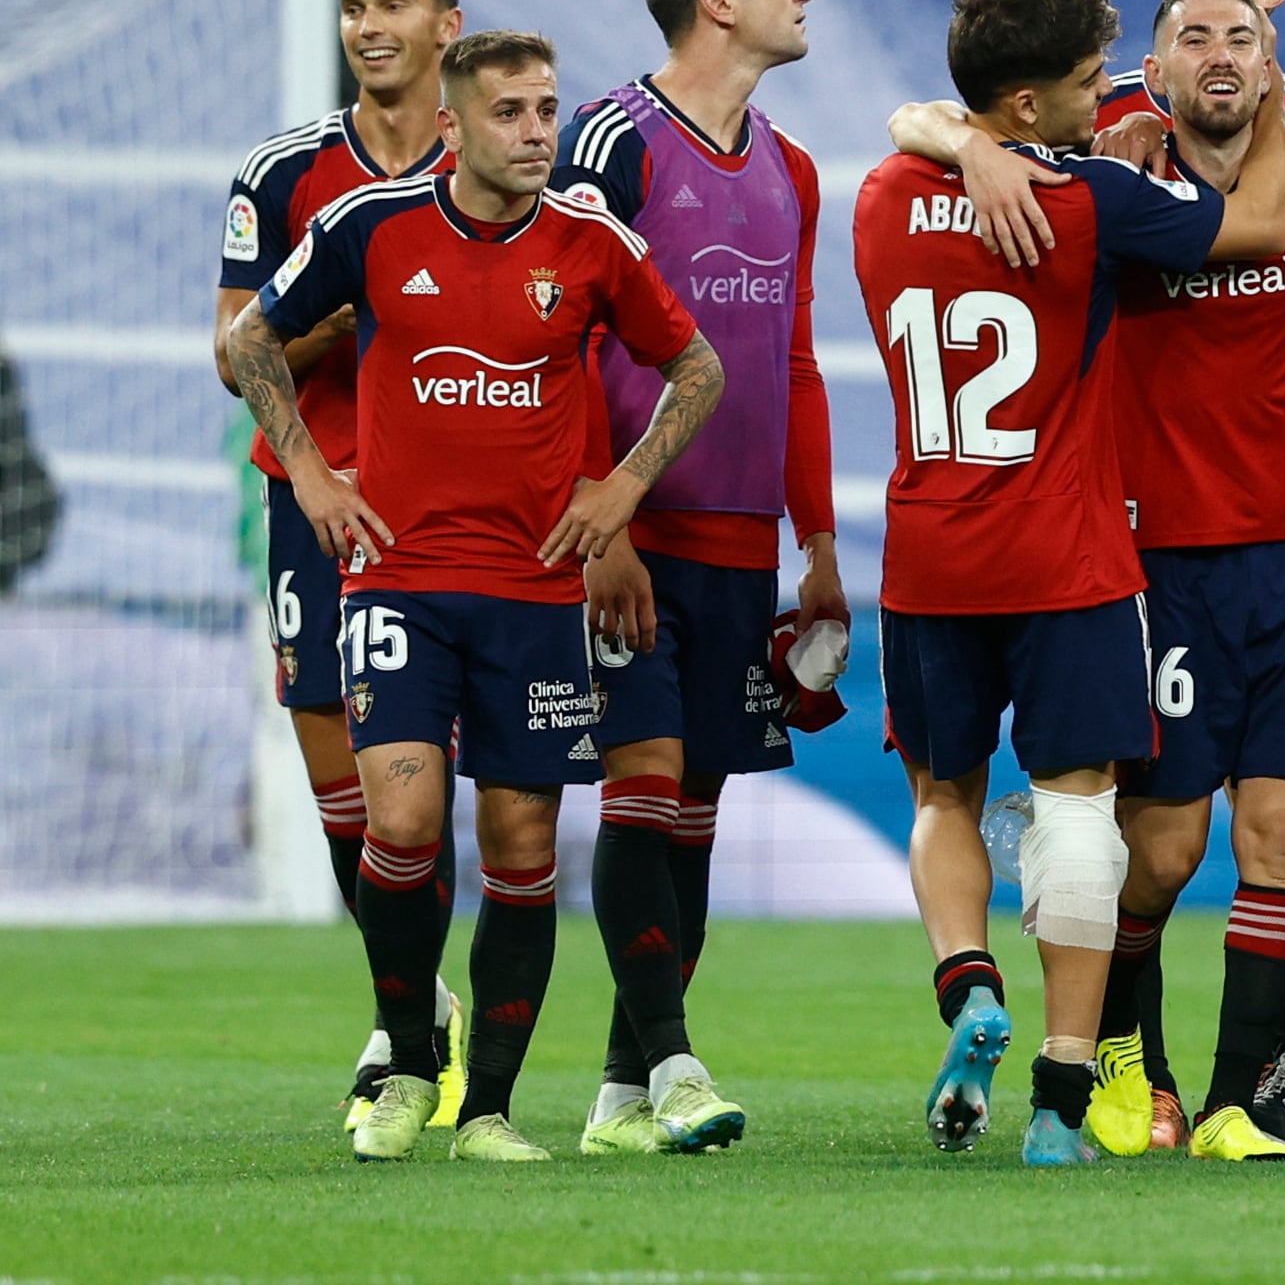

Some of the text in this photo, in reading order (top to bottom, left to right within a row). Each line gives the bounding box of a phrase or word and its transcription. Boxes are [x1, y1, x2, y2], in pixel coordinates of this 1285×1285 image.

[227, 241, 255, 252] LaLiga
[402, 285, 440, 295] adidas
[689, 268, 789, 305] verleal
[411, 371, 543, 408] verleal
[886, 287, 1037, 466] 12
[277, 570, 302, 640] 6
[348, 605, 409, 677] 15
[528, 680, 574, 699] Clínica
[1156, 647, 1194, 718] 6
[528, 713, 547, 731] de
